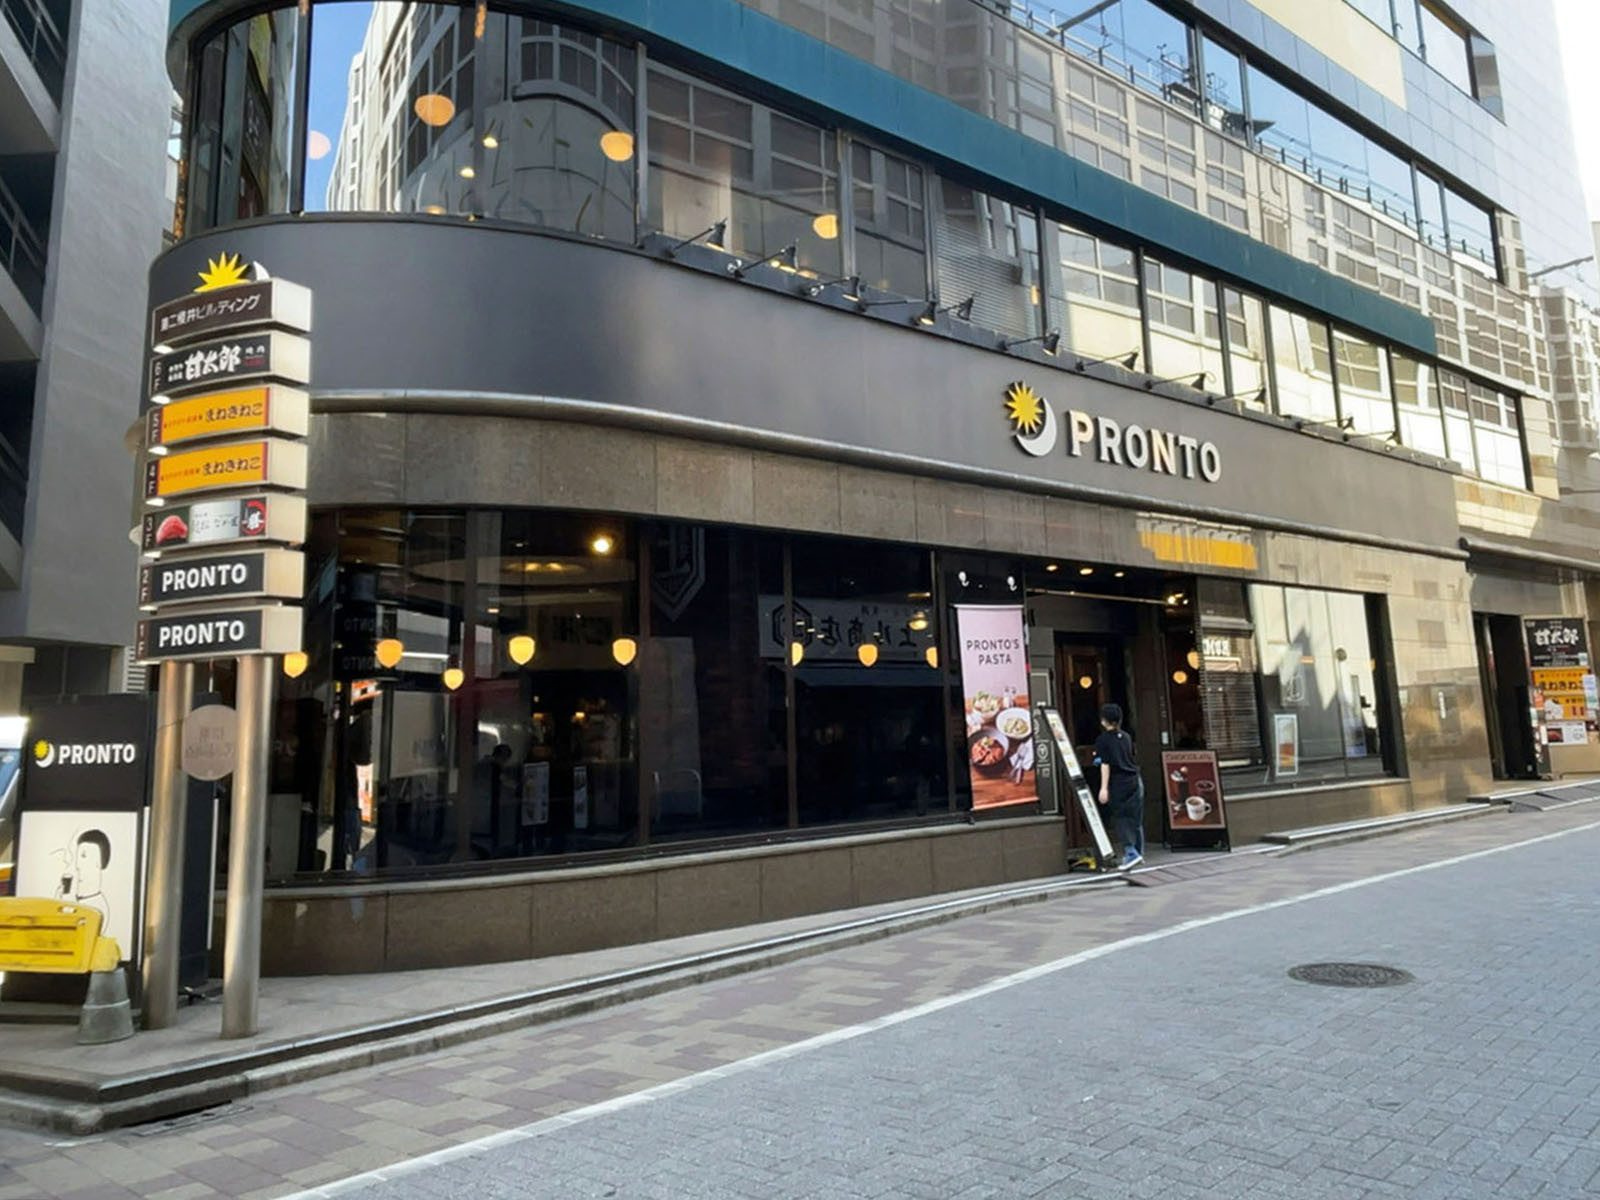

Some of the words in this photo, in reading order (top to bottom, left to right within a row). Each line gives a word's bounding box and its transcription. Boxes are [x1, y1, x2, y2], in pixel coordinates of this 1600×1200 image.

[184, 344, 242, 381] 甘太郎
[205, 402, 263, 422] まねきねこ
[1067, 408, 1222, 484] PRONTO
[203, 456, 262, 476] まねきねこ
[161, 562, 248, 593] PRONTO
[158, 619, 246, 649] PRONTO
[1534, 627, 1580, 647] 甘太郎
[966, 638, 1020, 652] PRONTO'S
[978, 653, 1013, 666] PASTA
[57, 742, 137, 765] PRONTO
